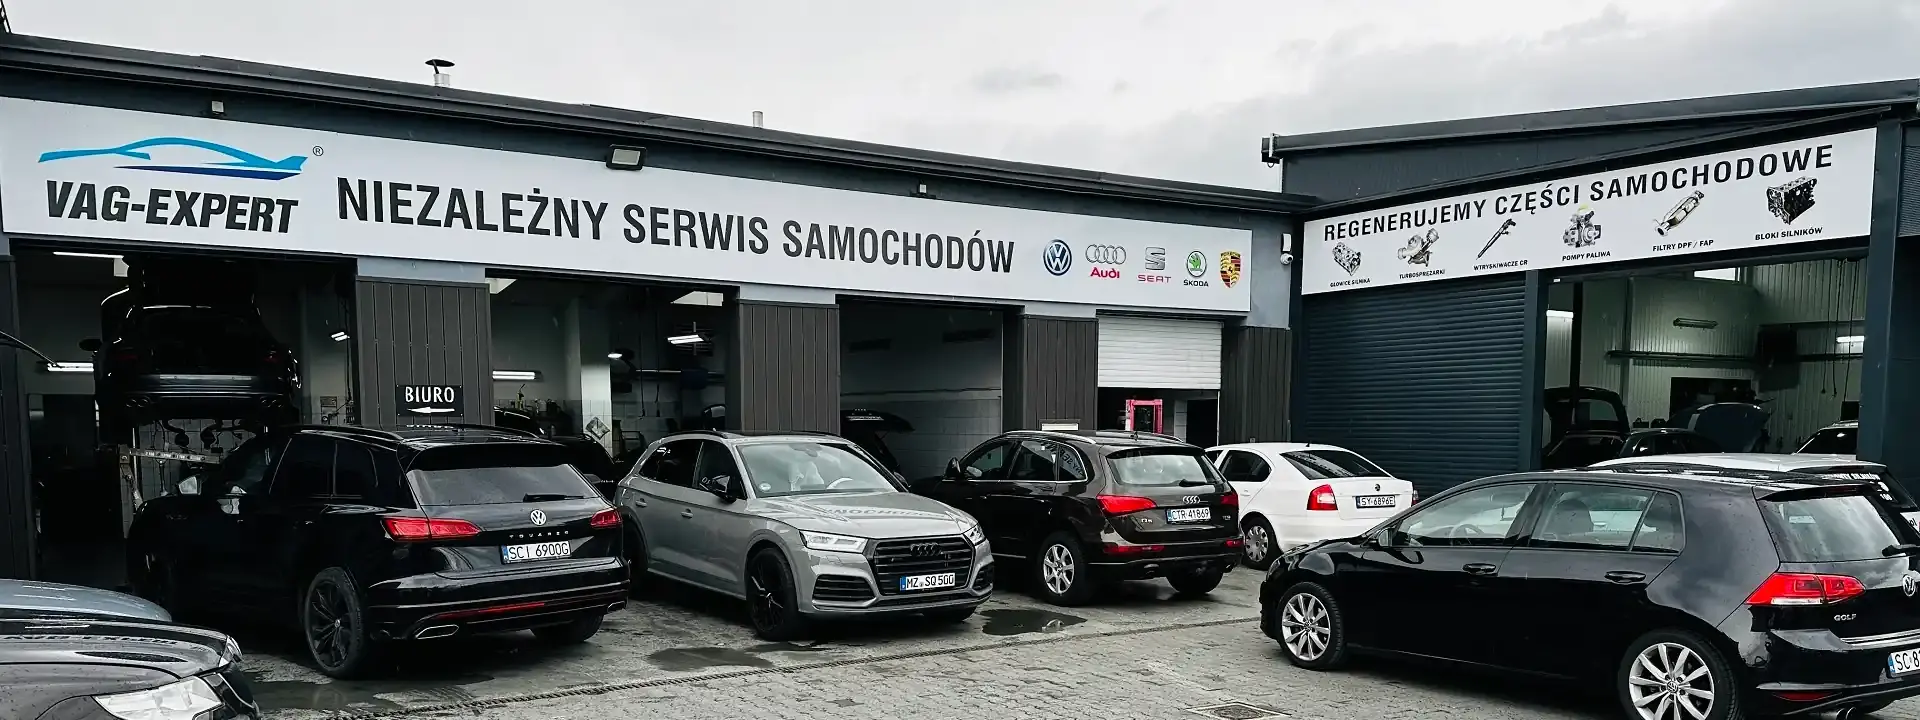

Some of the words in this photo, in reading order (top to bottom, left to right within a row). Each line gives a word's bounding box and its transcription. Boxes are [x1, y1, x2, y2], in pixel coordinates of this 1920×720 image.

[1324, 199, 1487, 242] REGENERUJEMY
[1495, 182, 1580, 216] CZĘŚCI
[1589, 144, 1833, 202] SAMOCHODOWE
[46, 179, 299, 234] VAG-EXPERT
[337, 176, 609, 241] NIEZALEŻNY
[623, 203, 770, 255] SERWIS
[782, 220, 1015, 274] SAMOCHODÓW
[1754, 231, 1779, 241] BLOKI
[1780, 226, 1824, 239] SILNIKÓW
[1652, 243, 1677, 252] FILTRY
[1677, 241, 1693, 249] DPF
[1699, 239, 1715, 247] FAP
[1561, 253, 1585, 262] POMPY
[1585, 250, 1611, 259] PALIWA
[1090, 266, 1120, 279] Audi
[1473, 260, 1518, 271] WTRYSKIWACZE
[1137, 274, 1172, 284] SEAT
[405, 386, 455, 403] BIURO
[1833, 613, 1857, 622] GOLF
[1894, 652, 1911, 671] SC
